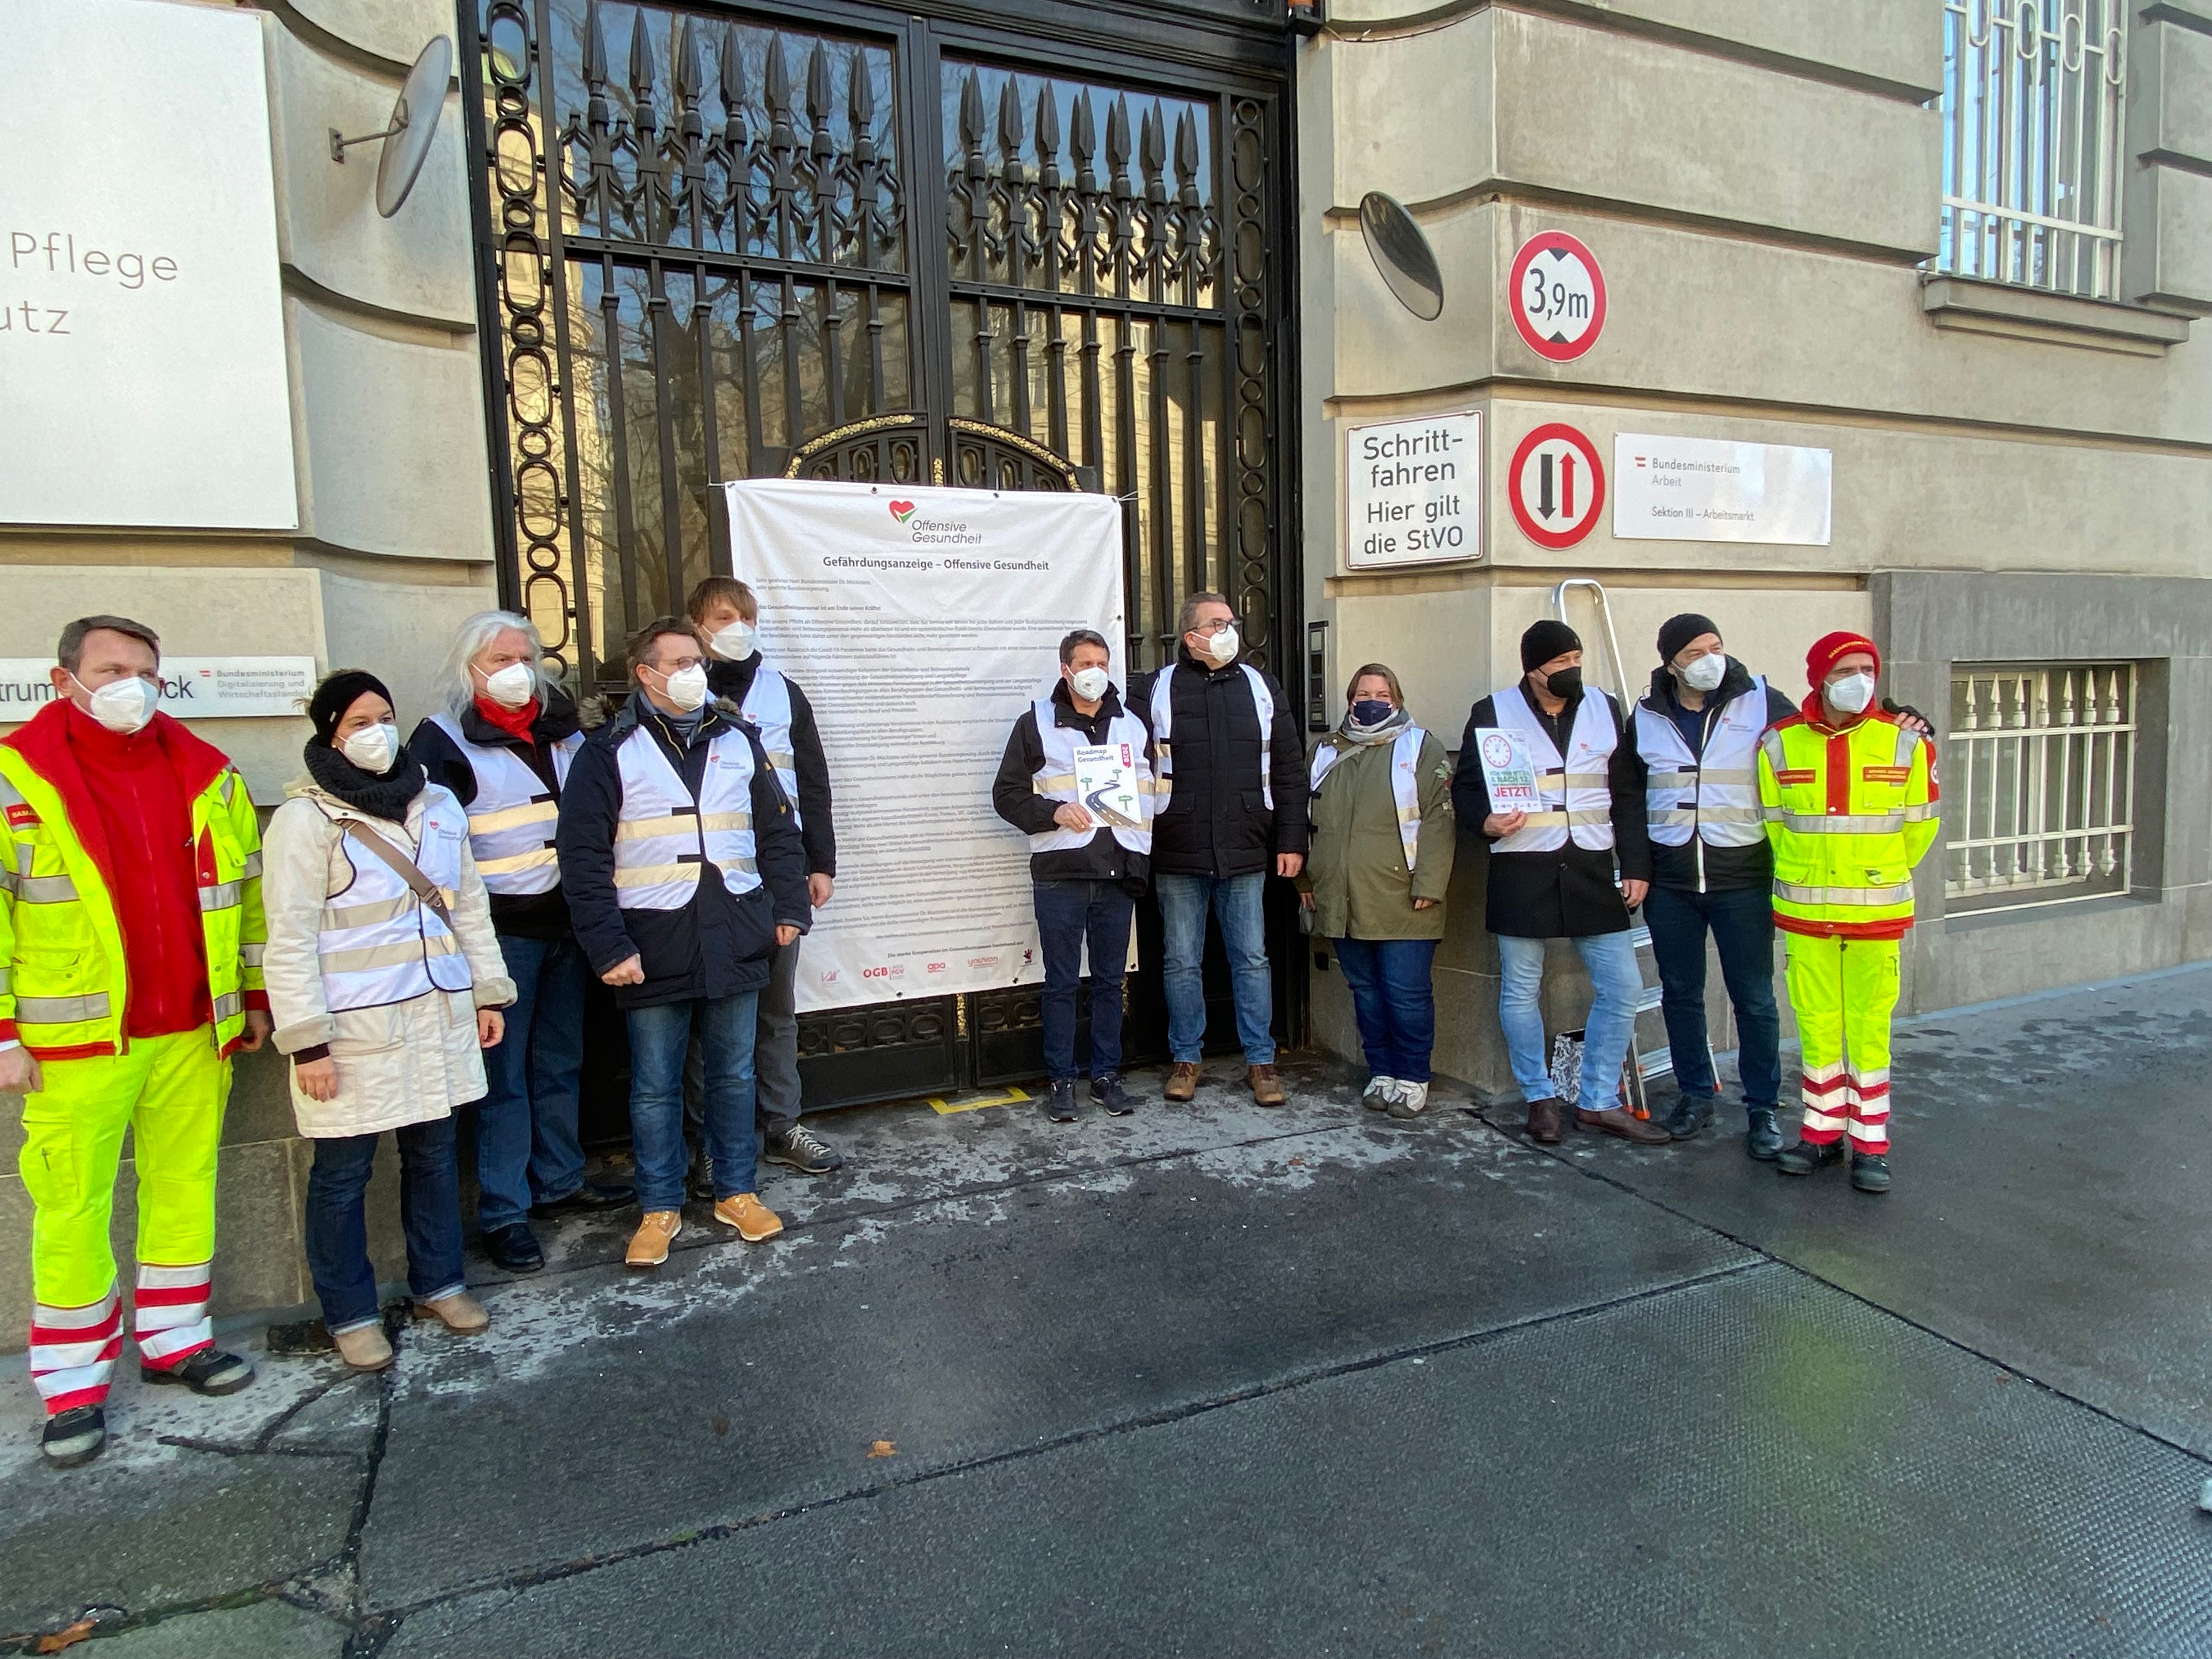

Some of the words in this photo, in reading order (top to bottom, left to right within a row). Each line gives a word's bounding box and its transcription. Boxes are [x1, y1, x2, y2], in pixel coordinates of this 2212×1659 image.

[11, 232, 178, 289] Pflege
[1528, 268, 1588, 321] 3,9m
[1363, 429, 1463, 460] Schritt-
[1652, 457, 1740, 474] Bundesministerium
[1371, 462, 1455, 488] fahren
[1652, 474, 1682, 487] Arbeit
[1368, 500, 1415, 524] Hier
[1425, 494, 1460, 524] gilt
[1651, 505, 1683, 518] Sektion
[1703, 509, 1754, 521] Arbeitsmarkt
[911, 519, 967, 532] Offensive
[912, 532, 982, 544] Gesundheit
[1364, 533, 1396, 554] die
[1407, 526, 1463, 551] StVO
[823, 556, 933, 571] Gefährdungsanzeige
[943, 559, 992, 570] Offensive
[993, 560, 1050, 571] Gesundheit
[216, 669, 305, 677] Bundesministerium
[158, 675, 194, 699] ck
[217, 680, 285, 688] Digitalisierung
[288, 679, 305, 687] und
[1121, 746, 1130, 763] 2020
[1494, 786, 1533, 797] JETZT!
